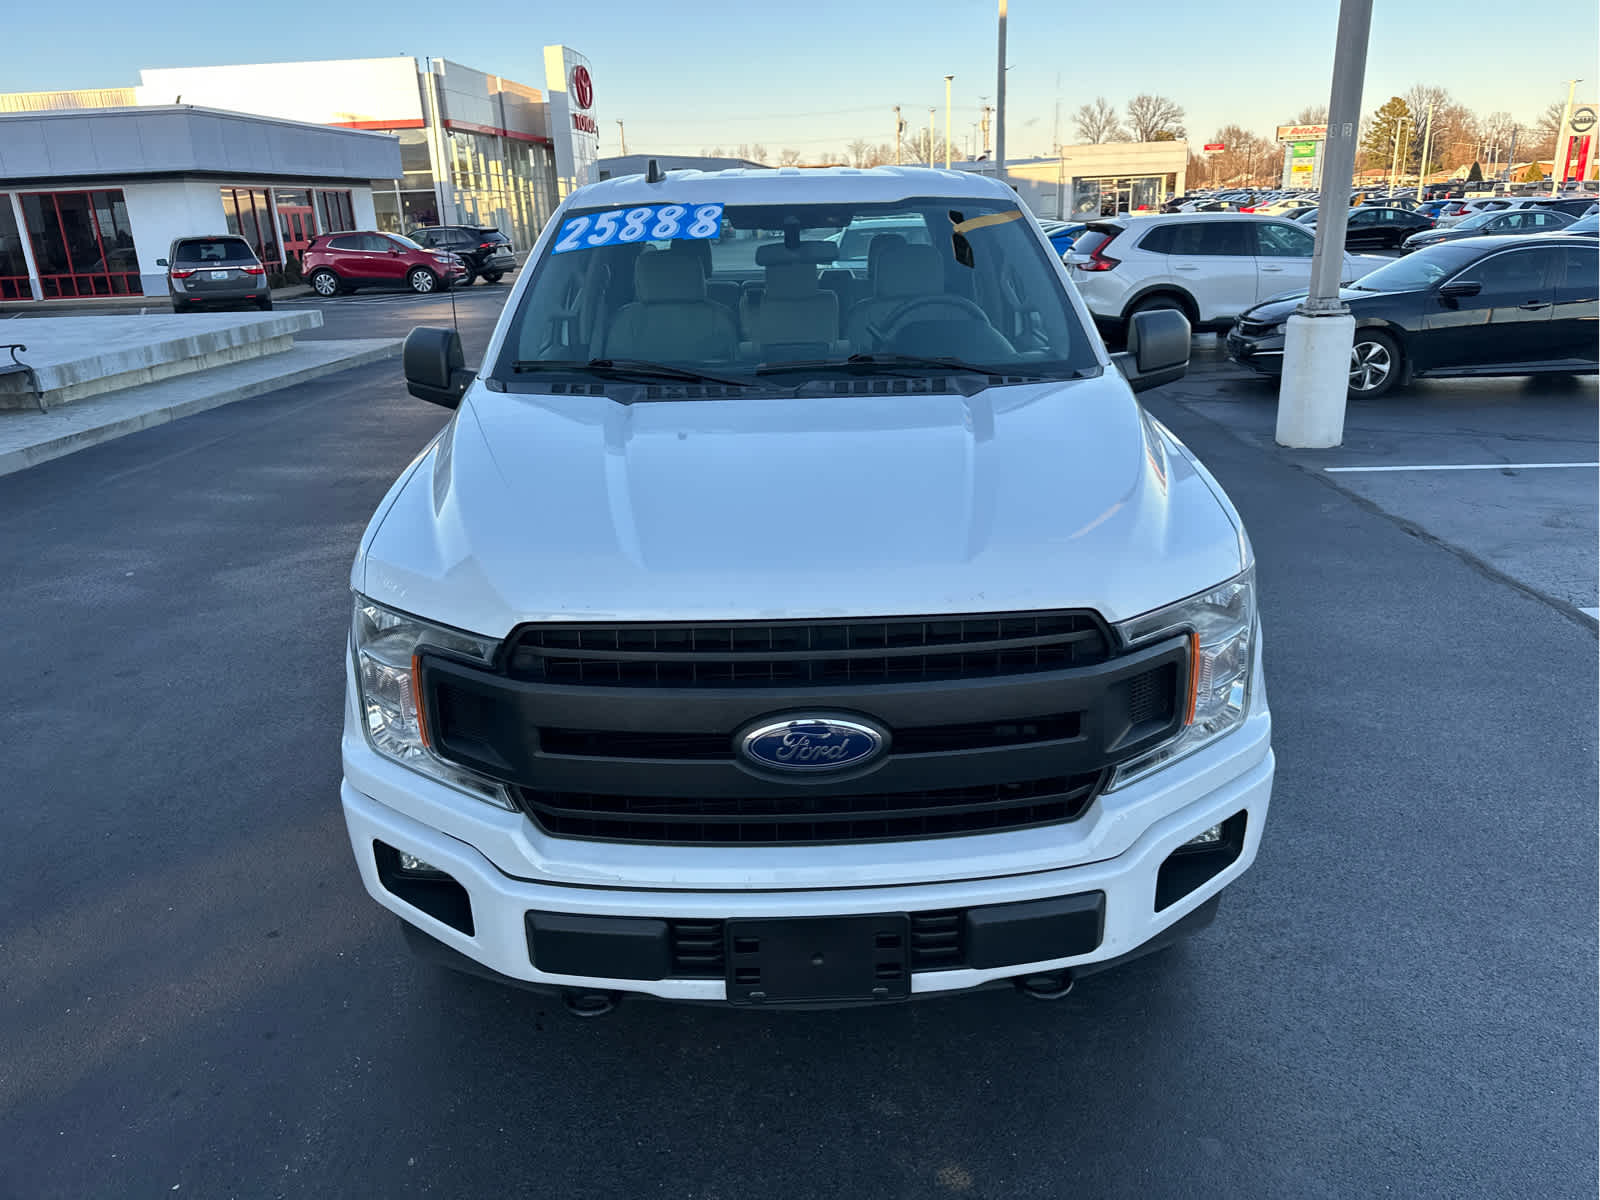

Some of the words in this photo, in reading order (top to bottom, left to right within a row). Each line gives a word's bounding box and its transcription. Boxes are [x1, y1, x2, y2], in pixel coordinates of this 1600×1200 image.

[1290, 126, 1327, 135] AutoZon
[555, 205, 723, 253] 25888
[776, 732, 850, 761] Ford
